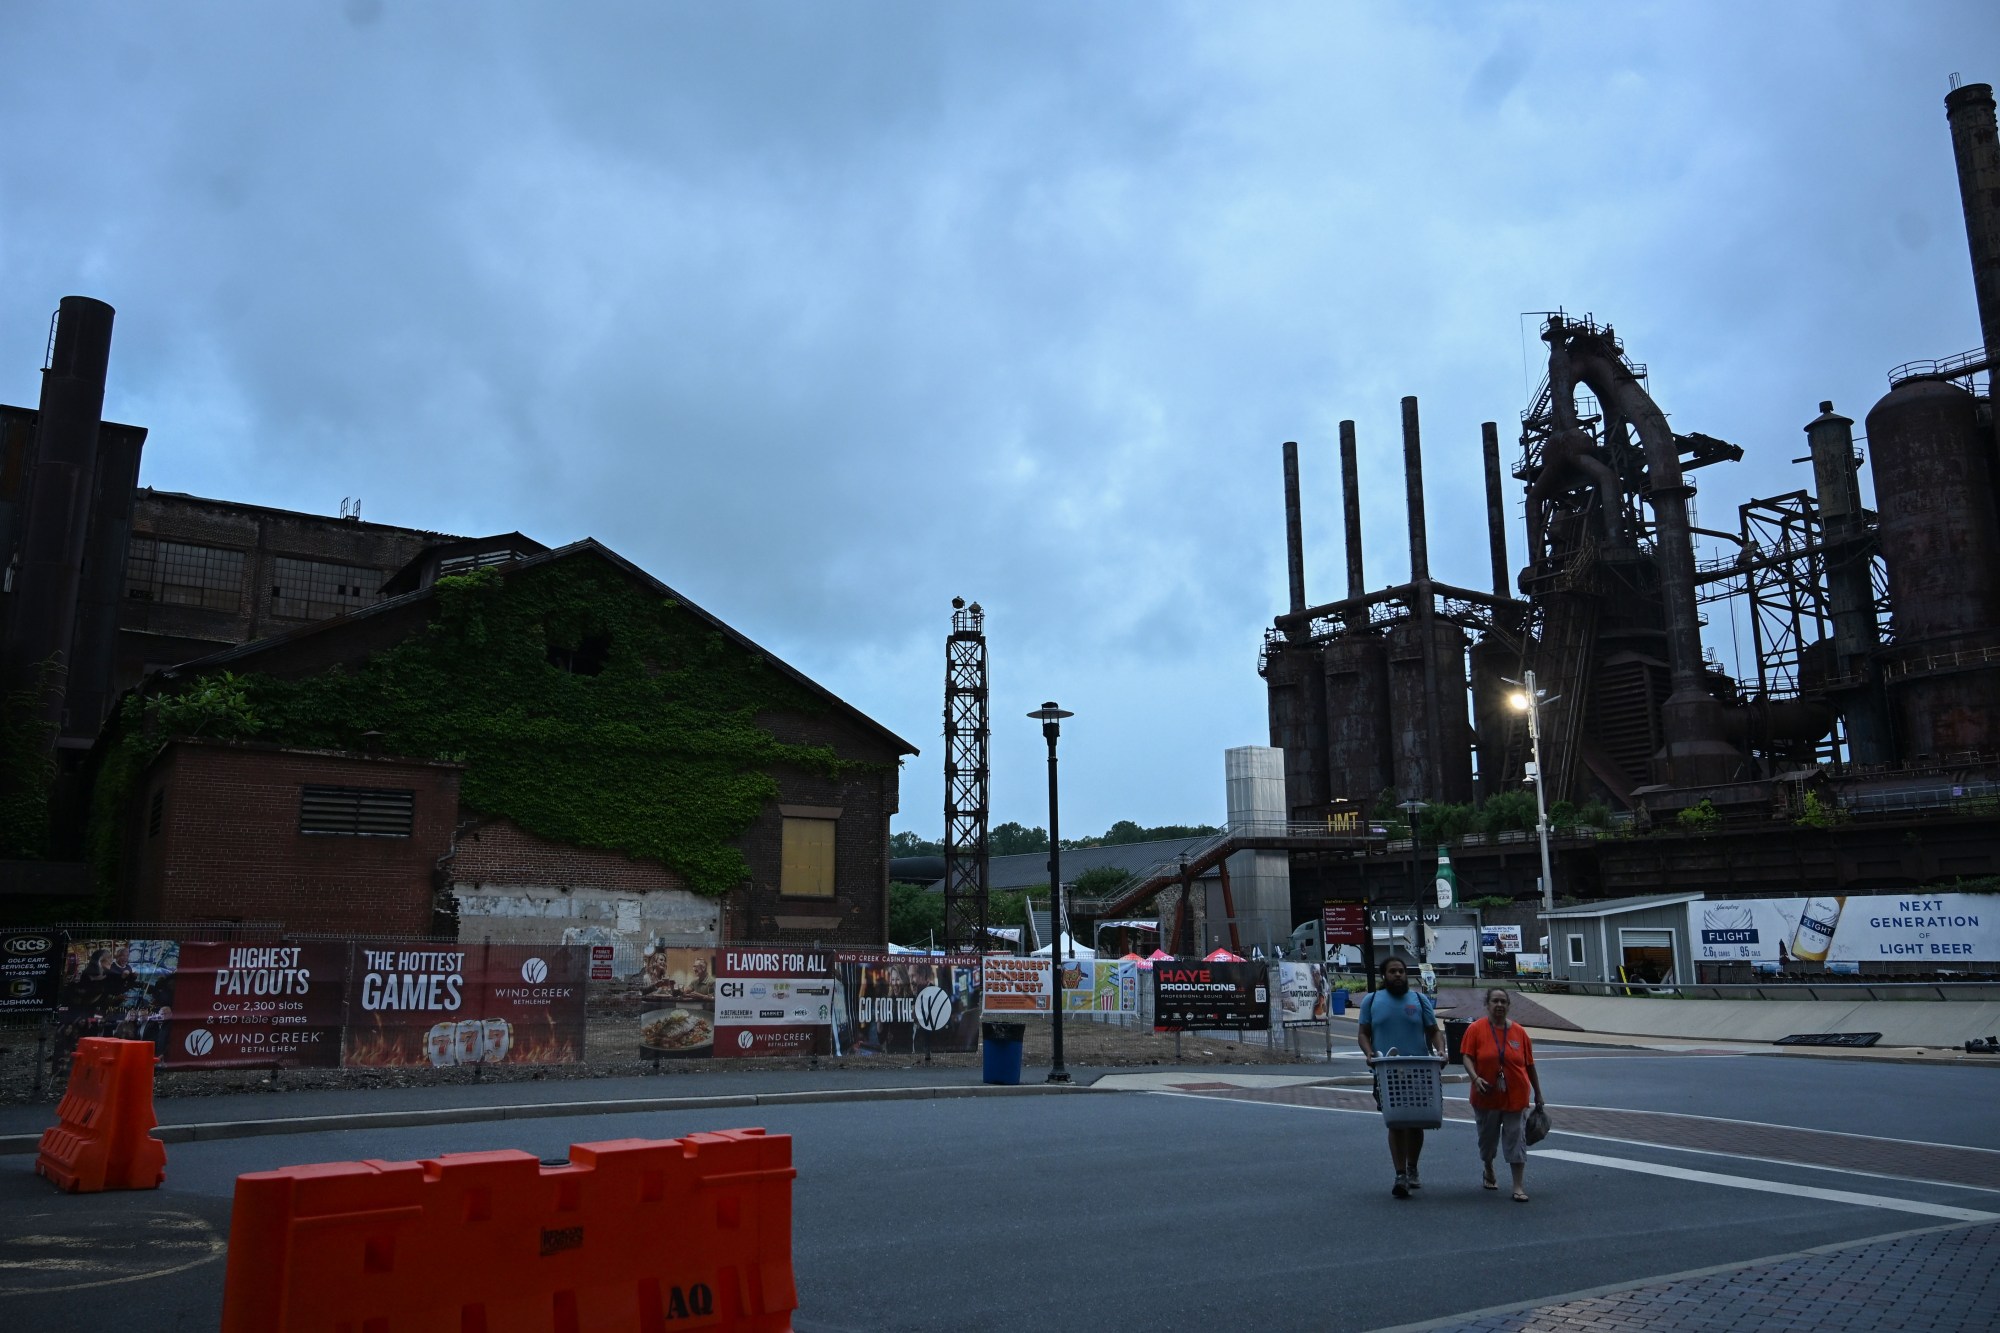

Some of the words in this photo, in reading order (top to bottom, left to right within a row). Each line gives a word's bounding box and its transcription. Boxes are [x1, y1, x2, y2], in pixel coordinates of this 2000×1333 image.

[1328, 811, 1358, 832] HMT
[1900, 900, 1943, 912] NEXT
[1380, 911, 1411, 921] Tuck
[1415, 914, 1440, 922] top
[1870, 916, 1979, 928] GENERATION
[1802, 918, 1833, 936] FLIGHT
[1709, 931, 1751, 941] FLIGHT
[16, 940, 46, 951] GCS
[1740, 946, 1750, 957] 95
[1880, 944, 1924, 954] LIGHT
[1931, 944, 1973, 954] BEER
[229, 948, 301, 968] HIGHEST
[367, 951, 395, 971] THE
[398, 951, 465, 972] HOTTEST
[726, 953, 780, 971] FLAVORS
[782, 954, 804, 971] FOR
[807, 955, 827, 972] ALL
[935, 957, 977, 965] BETHLEHEM
[985, 959, 1050, 972] ARTSQUEST
[214, 969, 310, 995] PAYOUTS
[985, 971, 1040, 982] MEMBERS
[1160, 969, 1211, 983] HAYE
[361, 972, 463, 1011] GAMES
[495, 989, 529, 997] WIND
[532, 988, 571, 997] CREEK
[721, 983, 744, 997] CH
[985, 982, 1014, 993] FEST
[1160, 983, 1236, 991] PRODUCTIONS
[213, 1002, 240, 1011] Over
[243, 1001, 275, 1012] 2,300
[279, 1001, 303, 1010] slots
[859, 997, 871, 1022] GO
[875, 997, 893, 1022] FOR
[896, 997, 914, 1023] THE
[207, 1016, 214, 1024] &
[219, 1015, 237, 1024] 150
[241, 1015, 268, 1024] table
[272, 1015, 307, 1026] games
[218, 1033, 265, 1044] WIND
[269, 1032, 320, 1043] CREEK
[783, 1033, 811, 1041] CREEK
[665, 1282, 714, 1320] AQ
